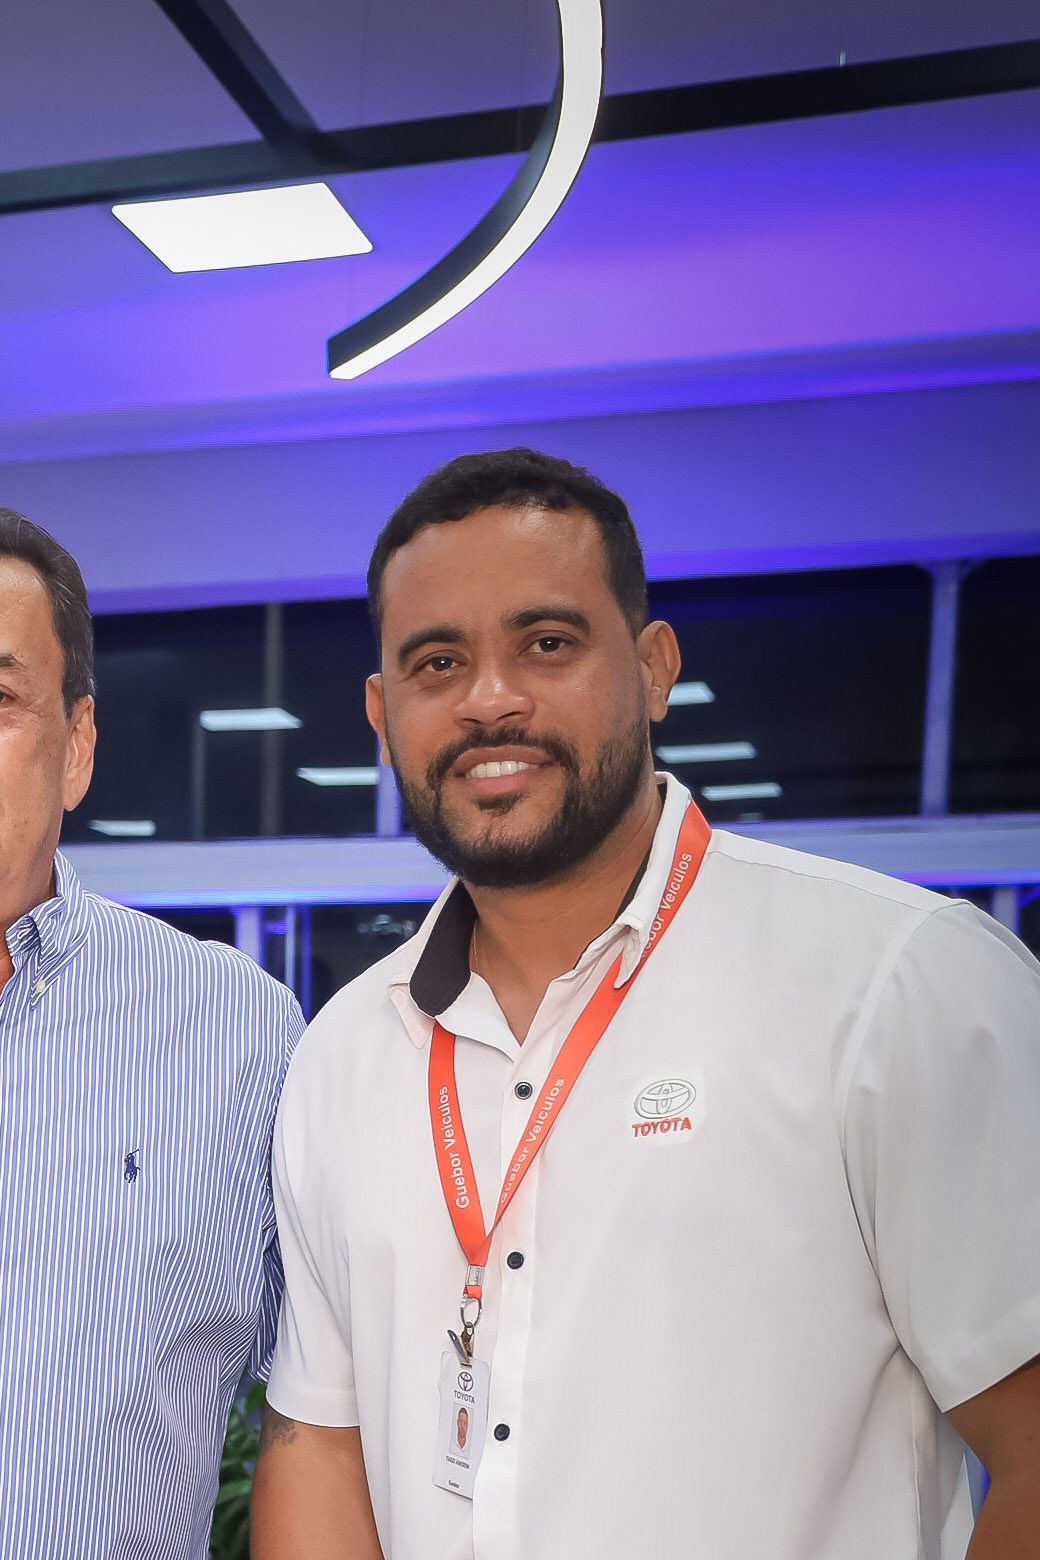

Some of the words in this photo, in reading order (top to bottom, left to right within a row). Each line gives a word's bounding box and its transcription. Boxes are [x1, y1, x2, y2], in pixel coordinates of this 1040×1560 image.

[632, 1117, 692, 1137] TOYOTA
[449, 1152, 469, 1208] Guebor
[501, 1147, 529, 1204] Guebor
[454, 1390, 475, 1404] TOYOTA
